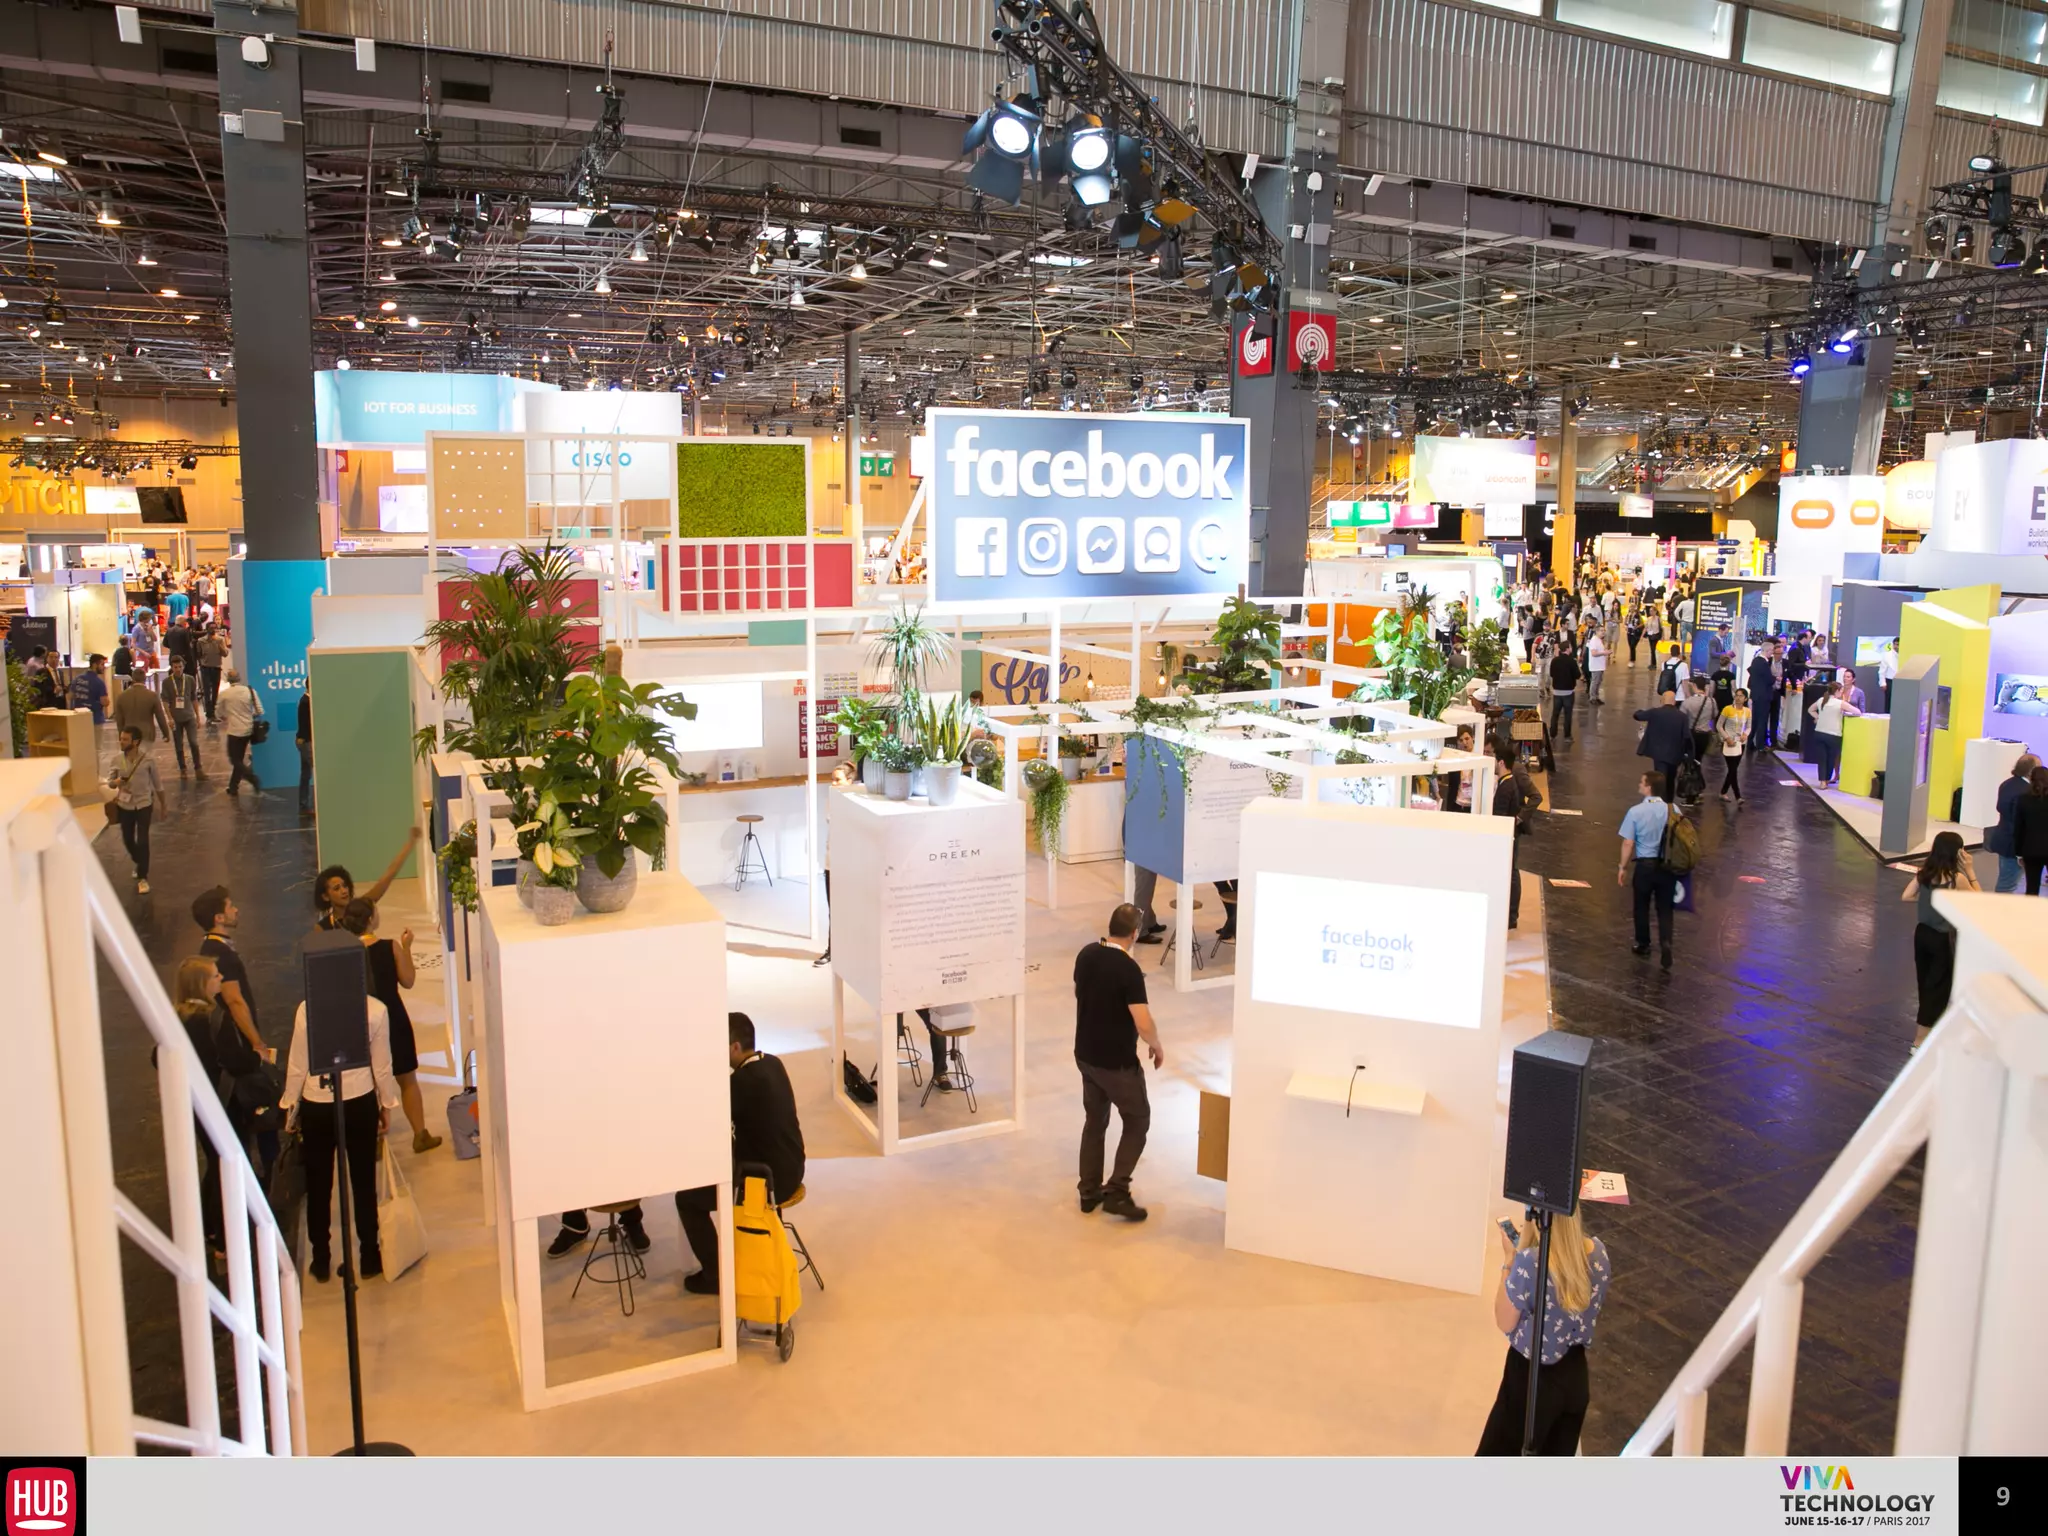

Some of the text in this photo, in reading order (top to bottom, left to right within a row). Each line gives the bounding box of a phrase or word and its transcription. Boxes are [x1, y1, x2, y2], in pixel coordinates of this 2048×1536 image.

[364, 401, 478, 415] IOT FOR BUSINESS
[947, 425, 1234, 500] facebook
[2031, 486, 2048, 520] E
[929, 848, 981, 862] DREEM
[1321, 924, 1413, 953] facebook
[942, 970, 967, 978] facebook
